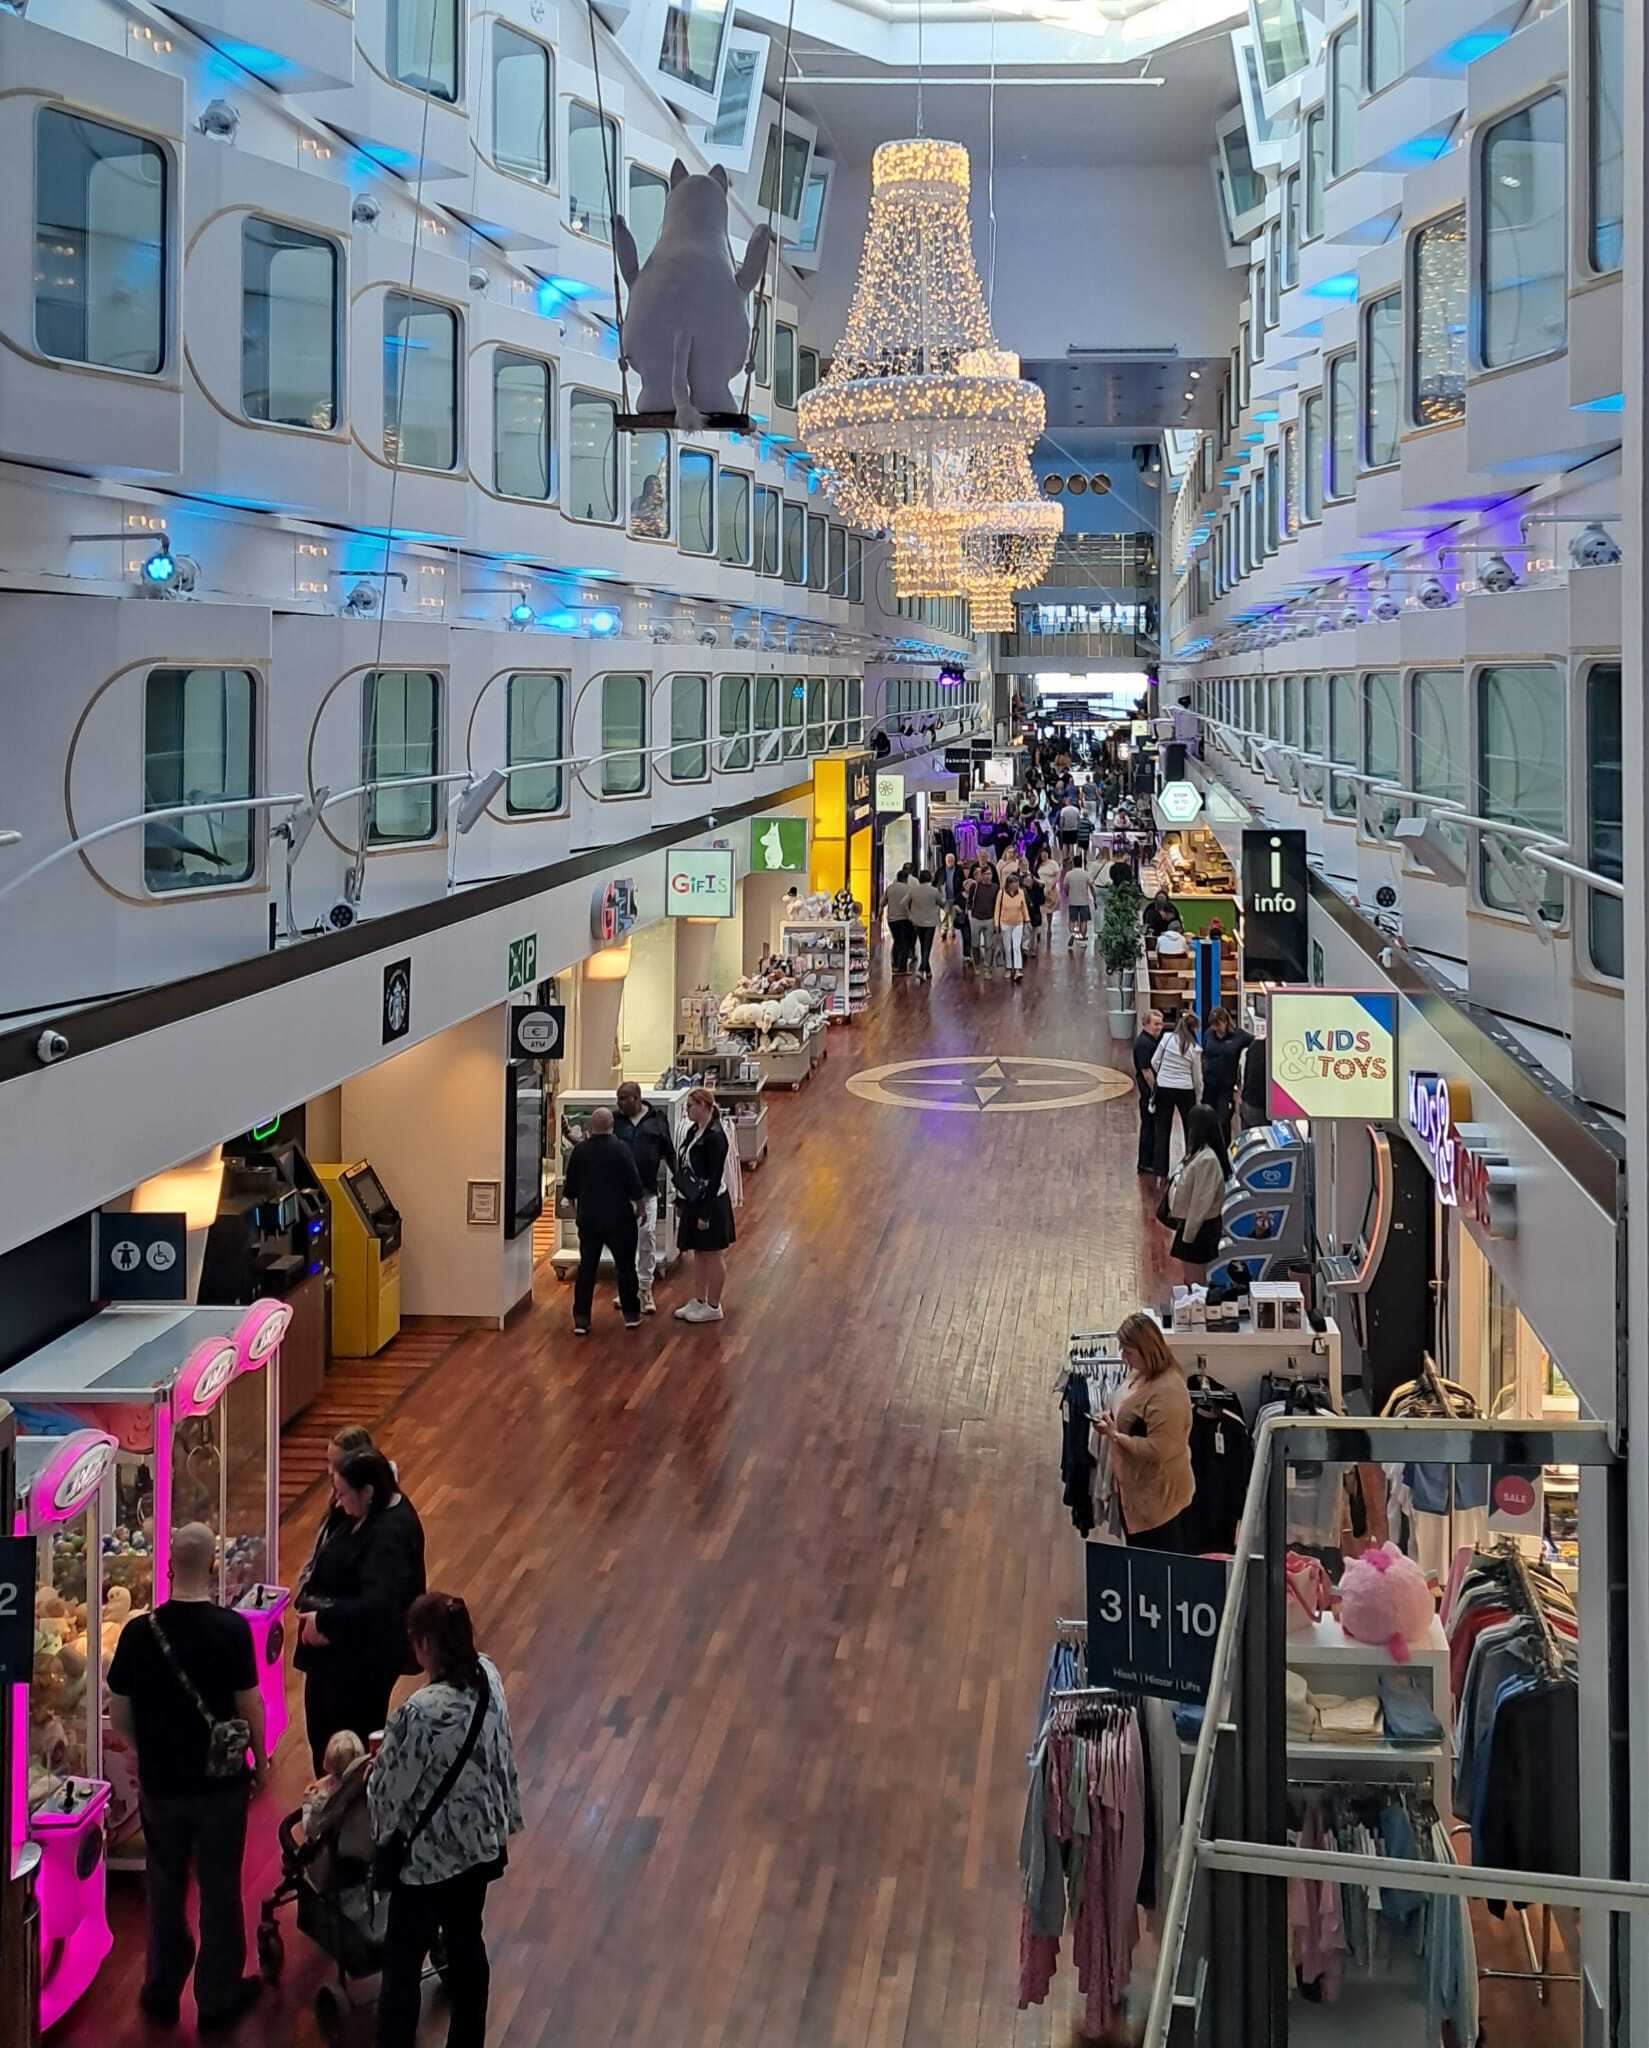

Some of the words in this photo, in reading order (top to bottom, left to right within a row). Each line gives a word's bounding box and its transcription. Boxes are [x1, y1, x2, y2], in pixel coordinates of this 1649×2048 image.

[1254, 892, 1296, 913] info
[530, 1040, 546, 1049] ATM
[1305, 1030, 1371, 1052] KIDS
[1280, 1040, 1319, 1081] &
[1318, 1056, 1387, 1080] TOYS
[1503, 1492, 1527, 1504] SALE
[1100, 1588, 1122, 1623] 3
[1139, 1593, 1162, 1629] 4
[1175, 1600, 1217, 1637] 10
